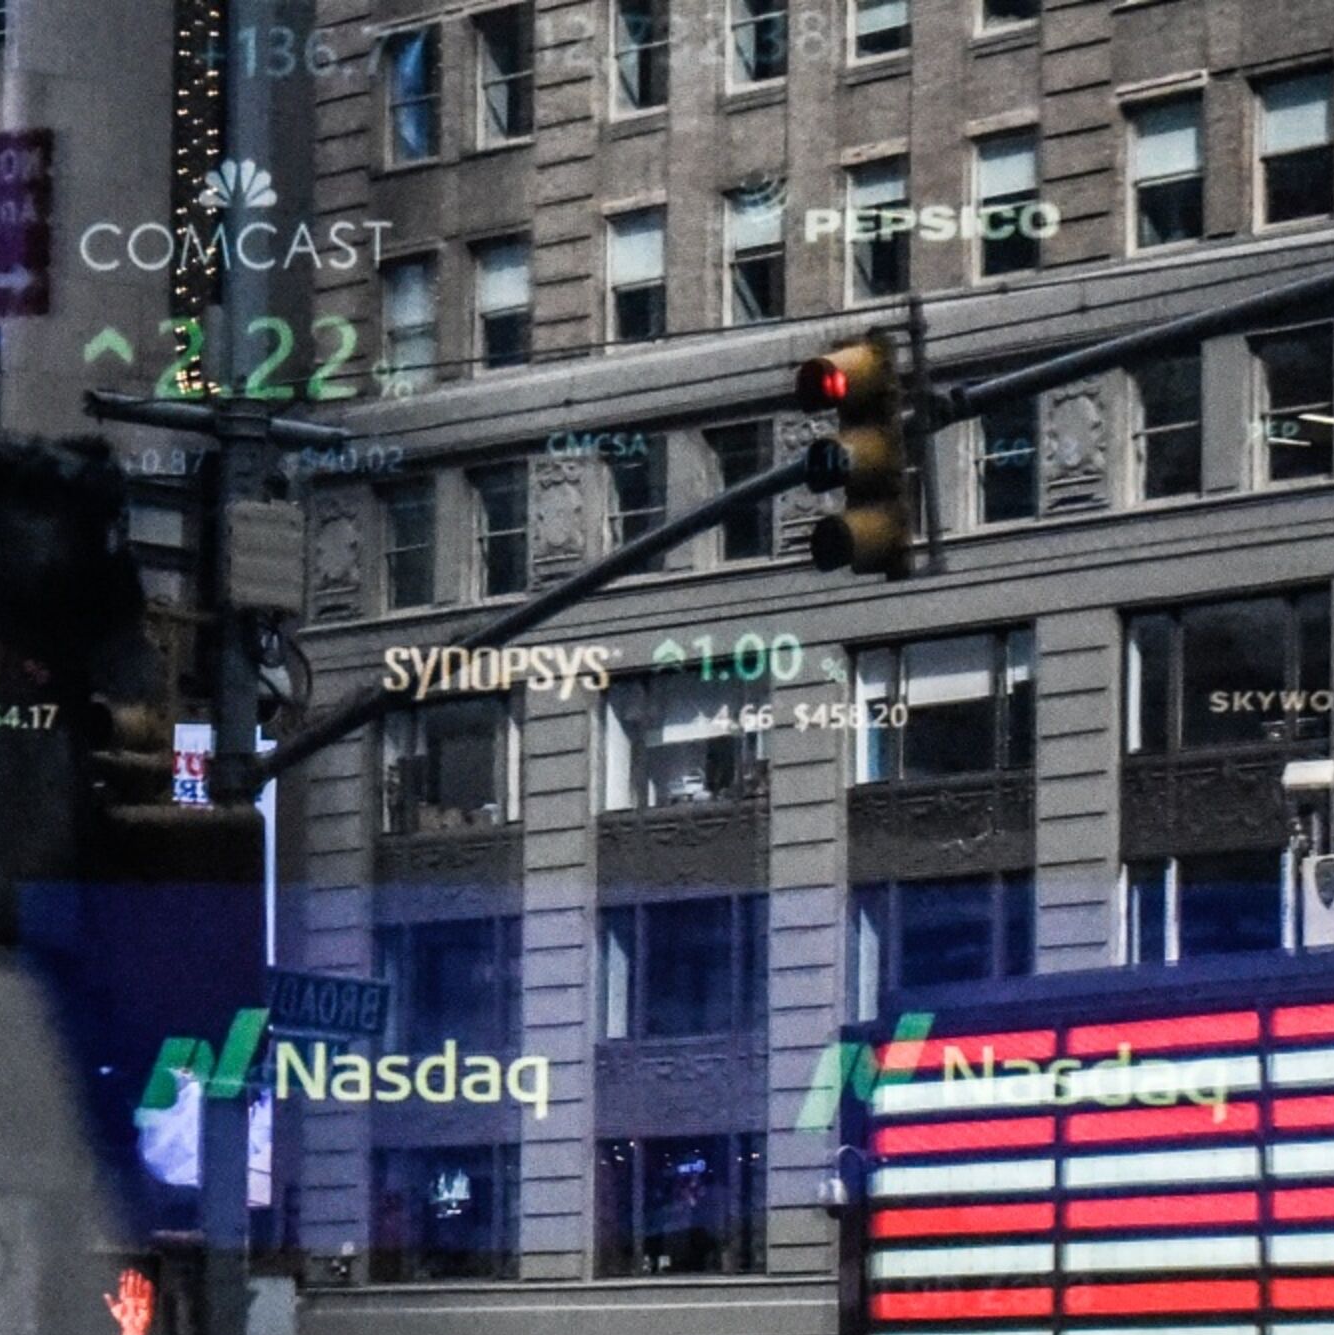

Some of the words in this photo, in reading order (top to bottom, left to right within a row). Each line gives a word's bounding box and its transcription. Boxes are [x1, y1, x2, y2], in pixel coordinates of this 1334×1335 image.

[79, 219, 394, 272] COMCAST
[804, 203, 1060, 243] PEPSICO
[383, 643, 612, 699] SYNOPSYS
[274, 1040, 550, 1120] Nasdaq
